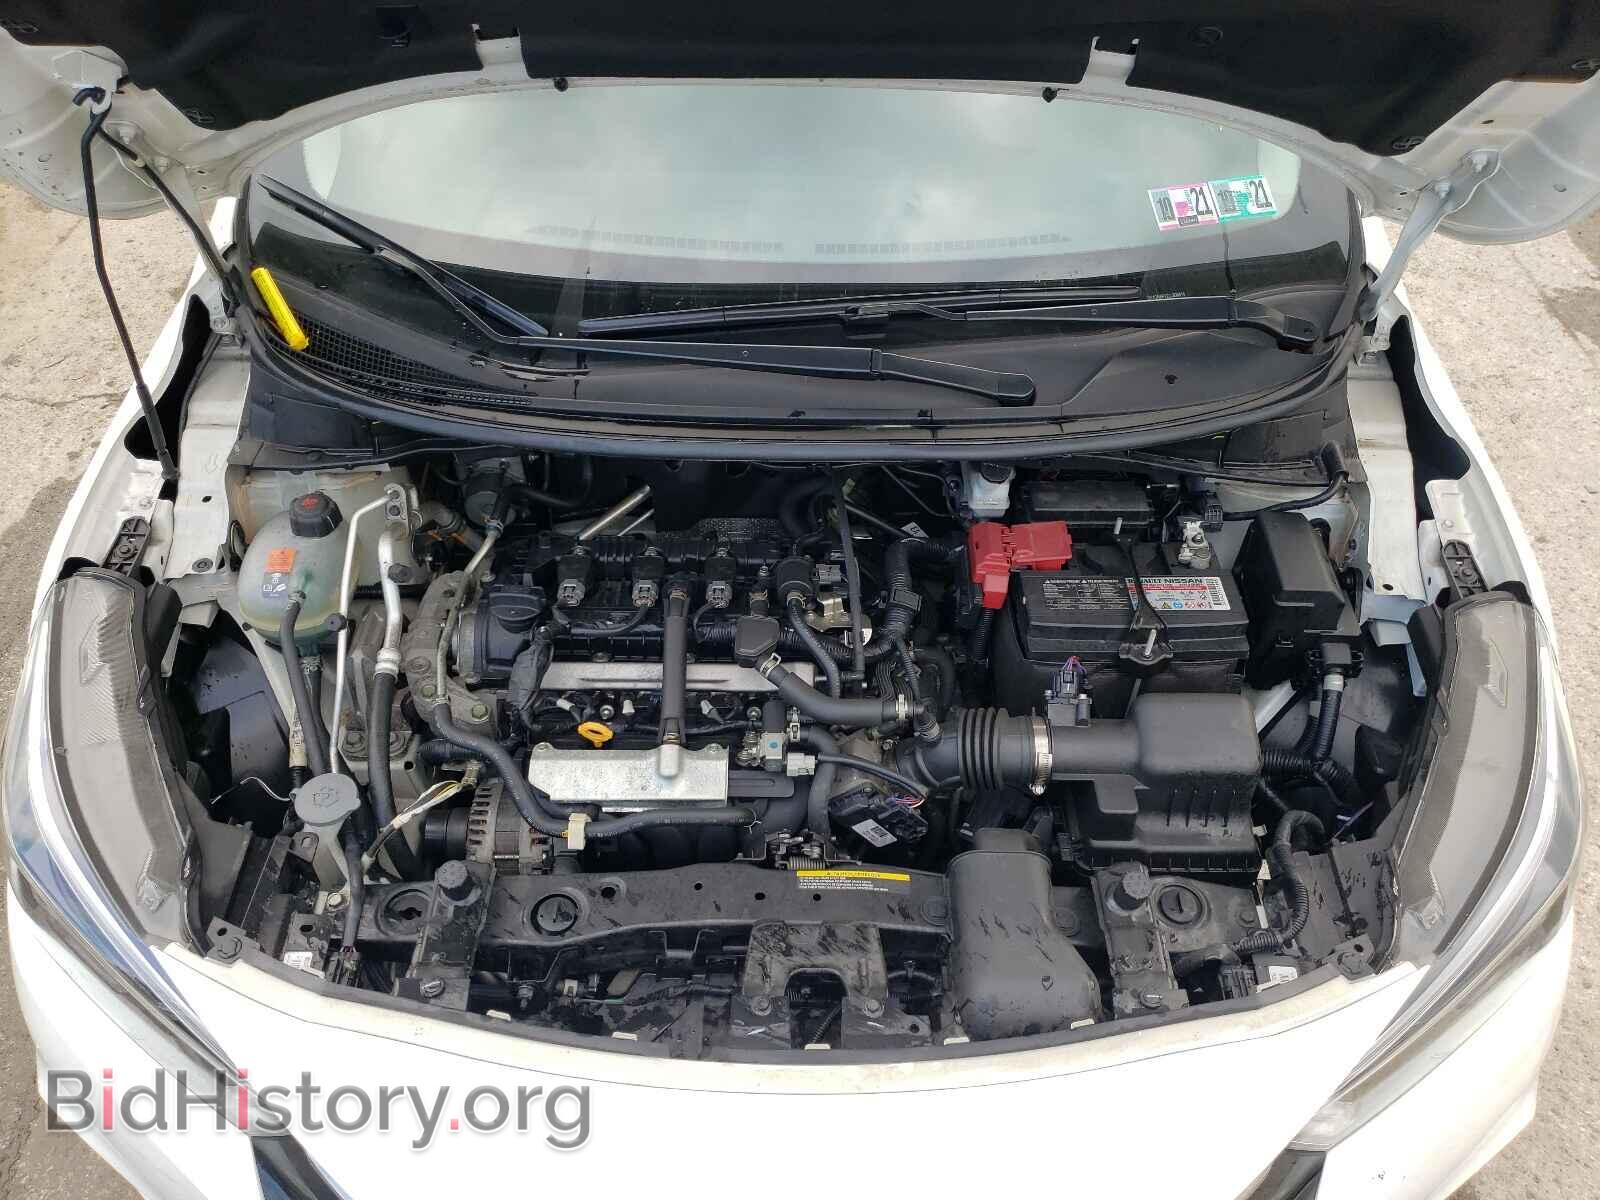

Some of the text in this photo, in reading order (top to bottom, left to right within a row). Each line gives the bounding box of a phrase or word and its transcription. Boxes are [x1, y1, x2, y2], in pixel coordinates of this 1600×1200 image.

[1156, 196, 1176, 221] 10
[1190, 187, 1213, 215] 21
[1249, 180, 1273, 208] 21
